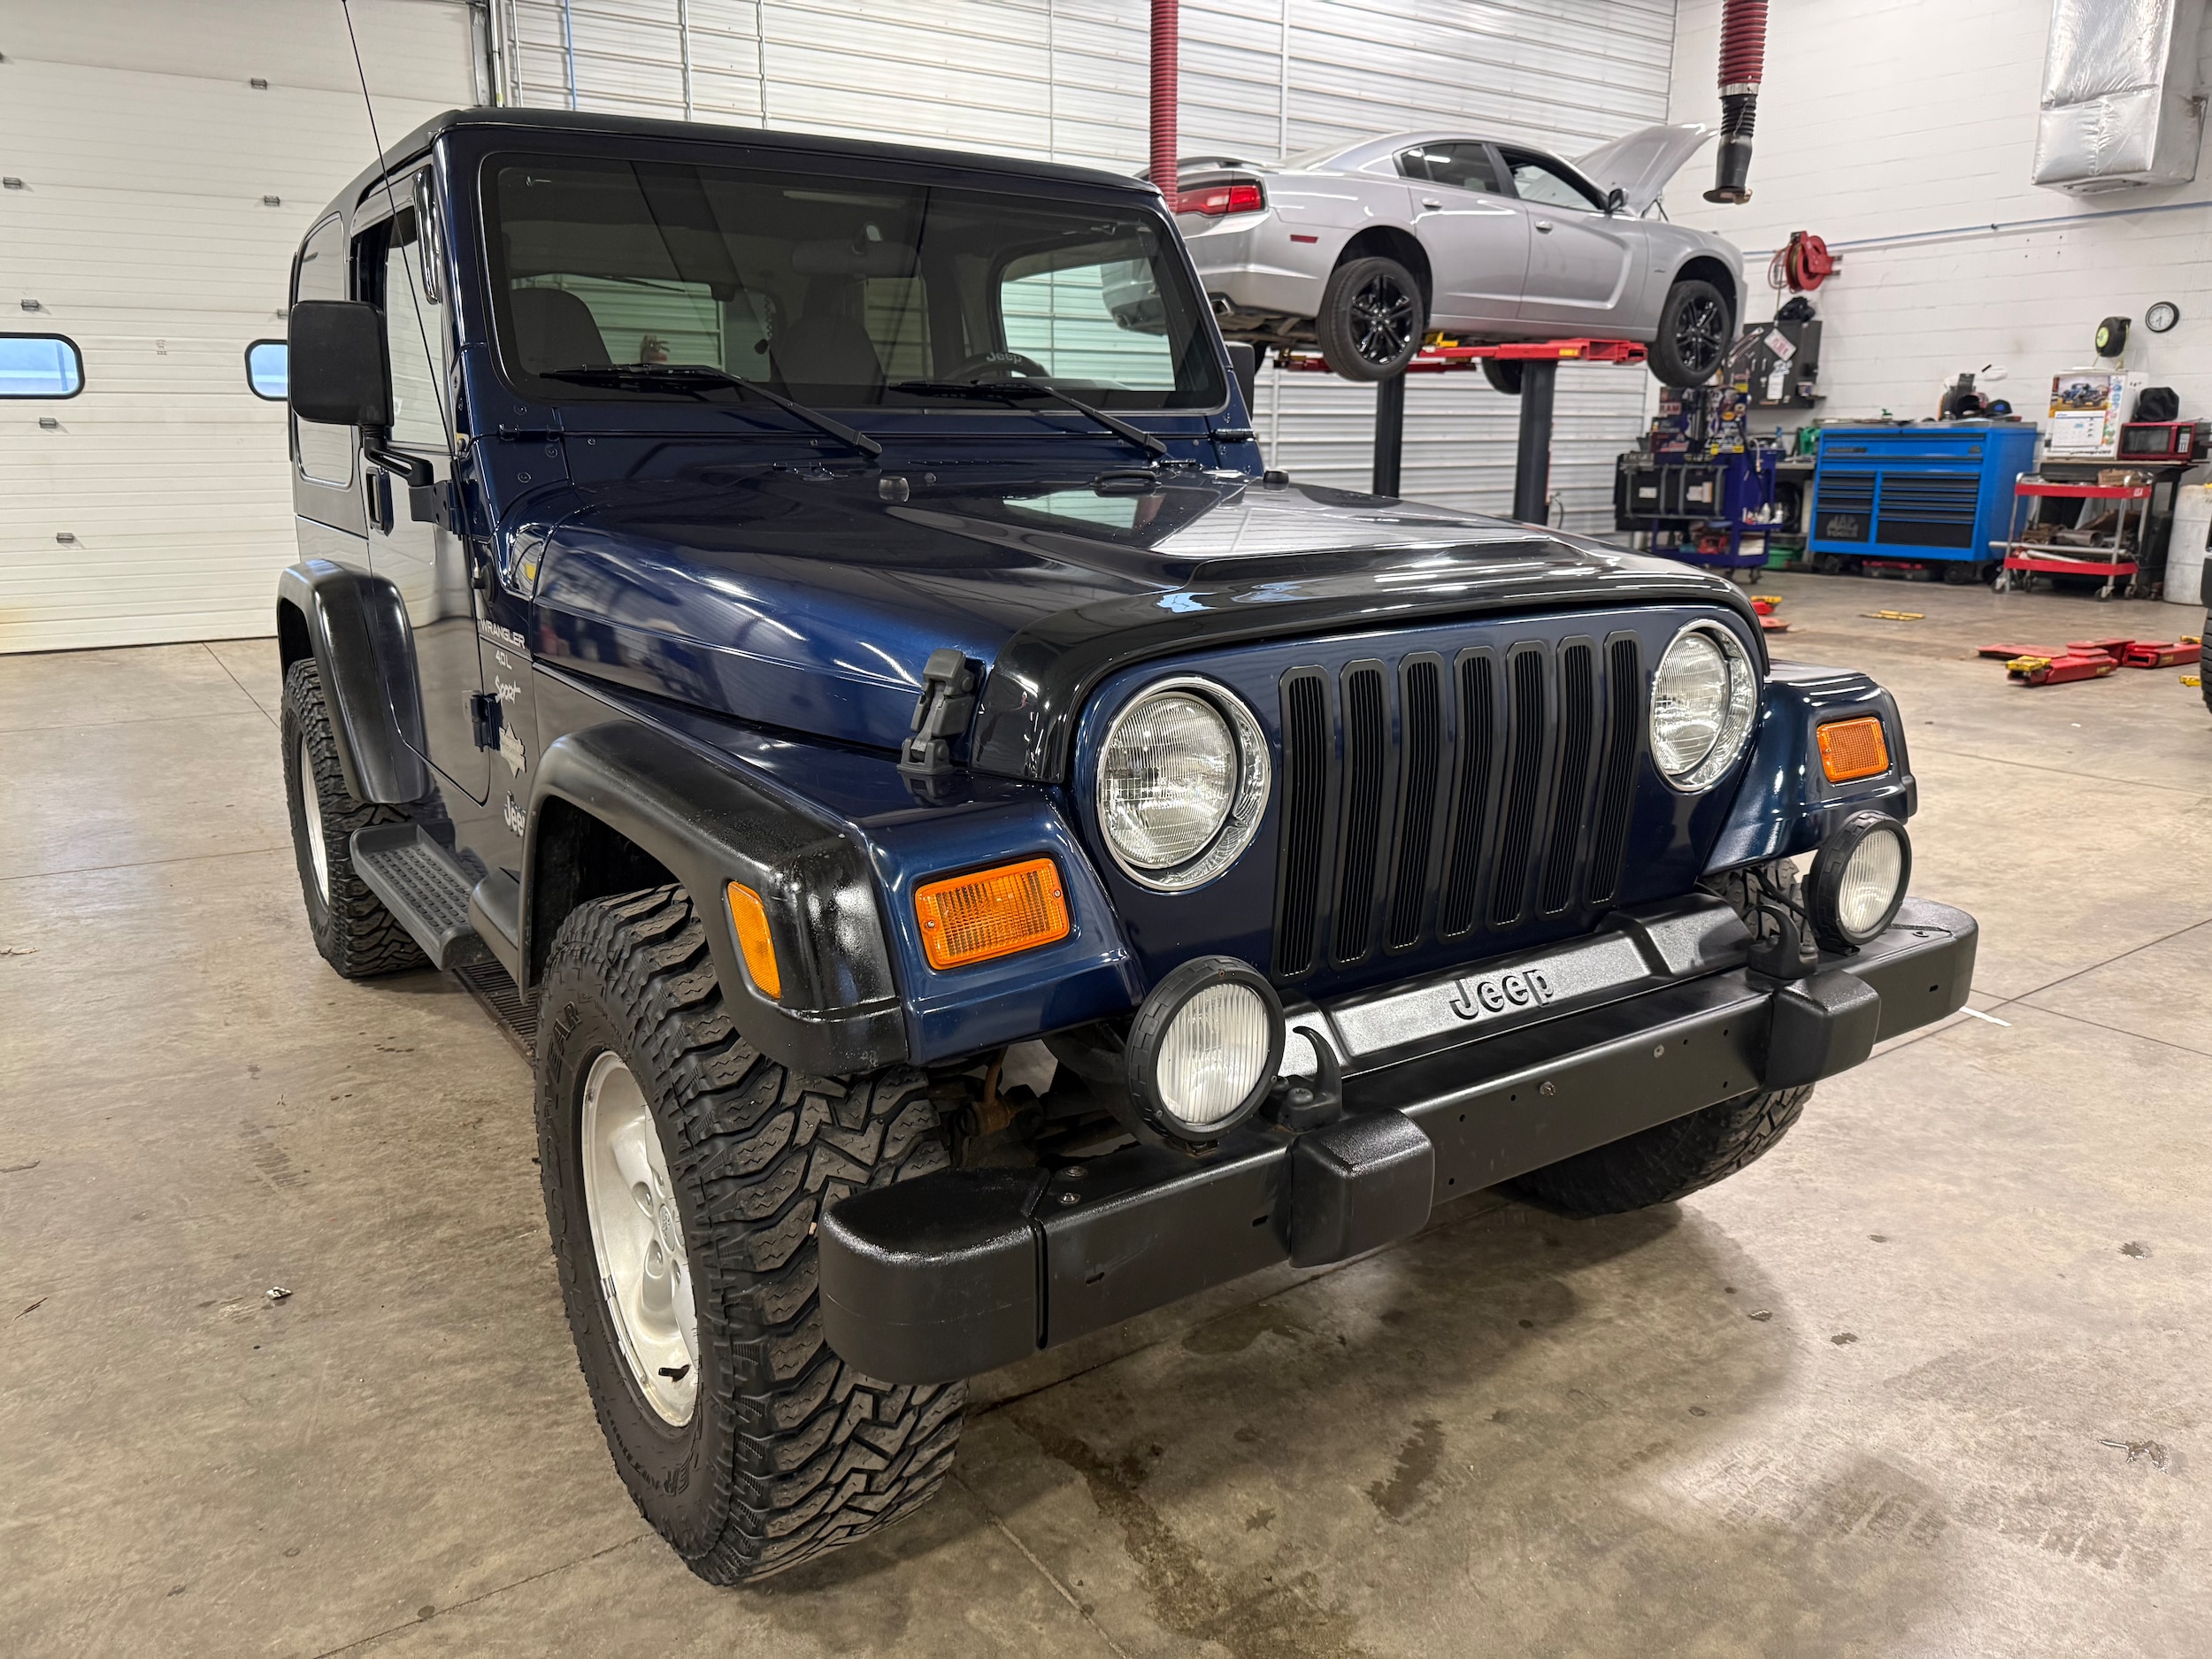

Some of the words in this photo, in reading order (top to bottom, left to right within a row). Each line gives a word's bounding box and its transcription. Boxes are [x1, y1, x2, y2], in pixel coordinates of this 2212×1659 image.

[986, 351, 1022, 365] Jeep
[480, 618, 526, 649] WRANGLER
[495, 675, 521, 707] Sport
[503, 790, 526, 837] Jee
[1449, 970, 1555, 1020] Jeep
